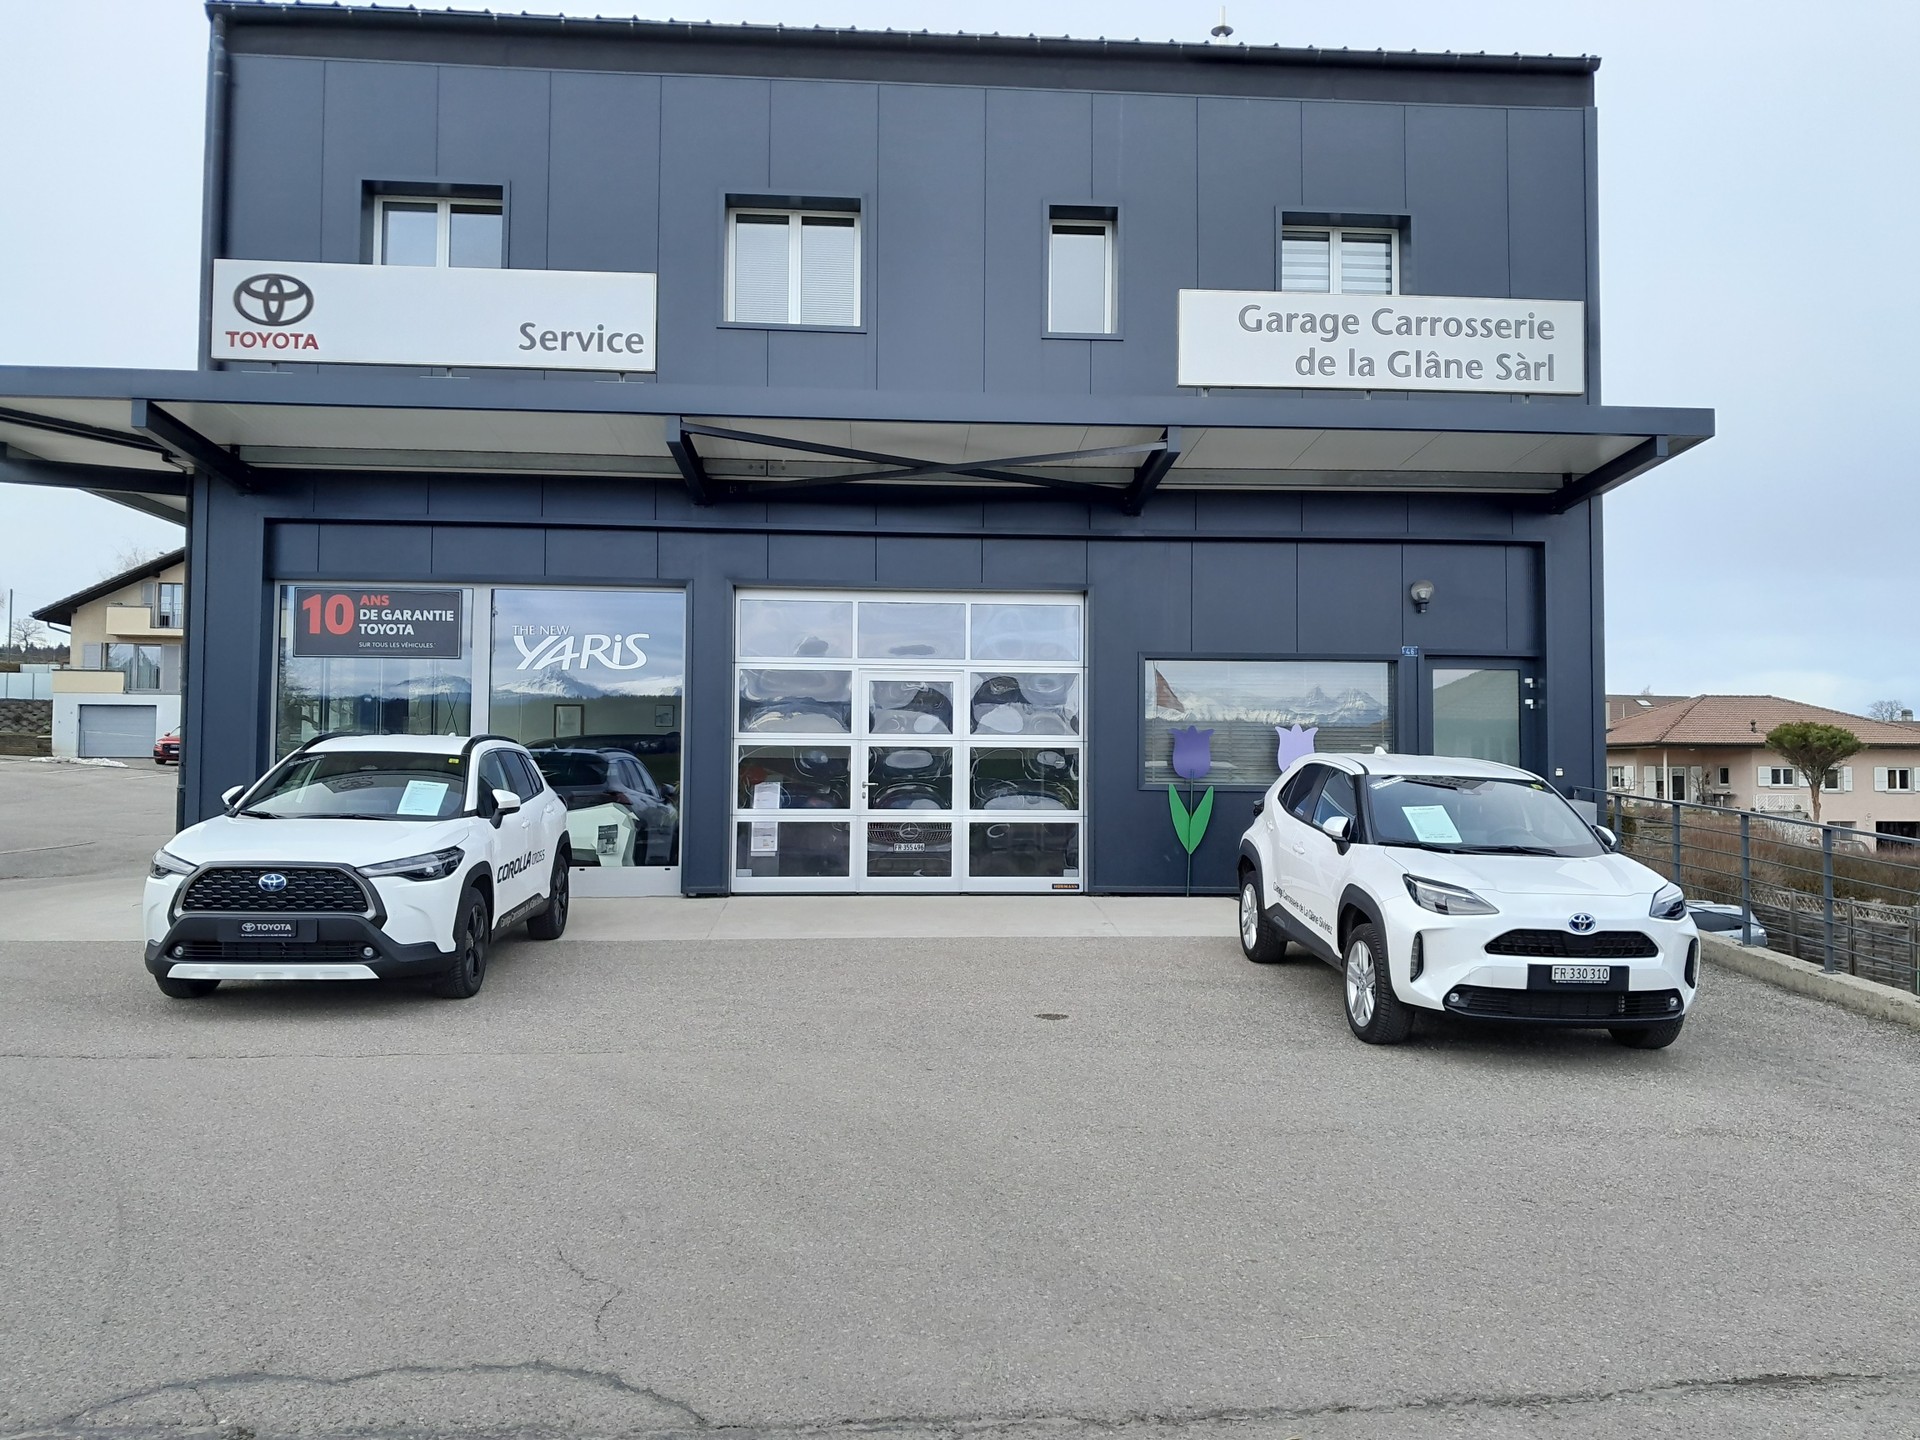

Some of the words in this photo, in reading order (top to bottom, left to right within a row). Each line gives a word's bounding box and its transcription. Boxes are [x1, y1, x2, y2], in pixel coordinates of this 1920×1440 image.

[1238, 304, 1360, 343] Garage
[1371, 307, 1555, 340] Carrosserie
[225, 331, 319, 350] TOYOTA
[518, 322, 645, 354] Service
[1295, 347, 1337, 376] de
[1348, 348, 1375, 377] la
[1387, 350, 1483, 380] Glâne
[1495, 352, 1554, 381] Sàrl
[360, 595, 389, 606] ANS
[302, 594, 355, 635] 10
[359, 609, 378, 621] DE
[381, 609, 454, 622] GARANTIE
[359, 623, 415, 635] TOYOTA
[512, 625, 536, 635] THE
[540, 625, 570, 635] NEW
[497, 851, 531, 883] COROLLA
